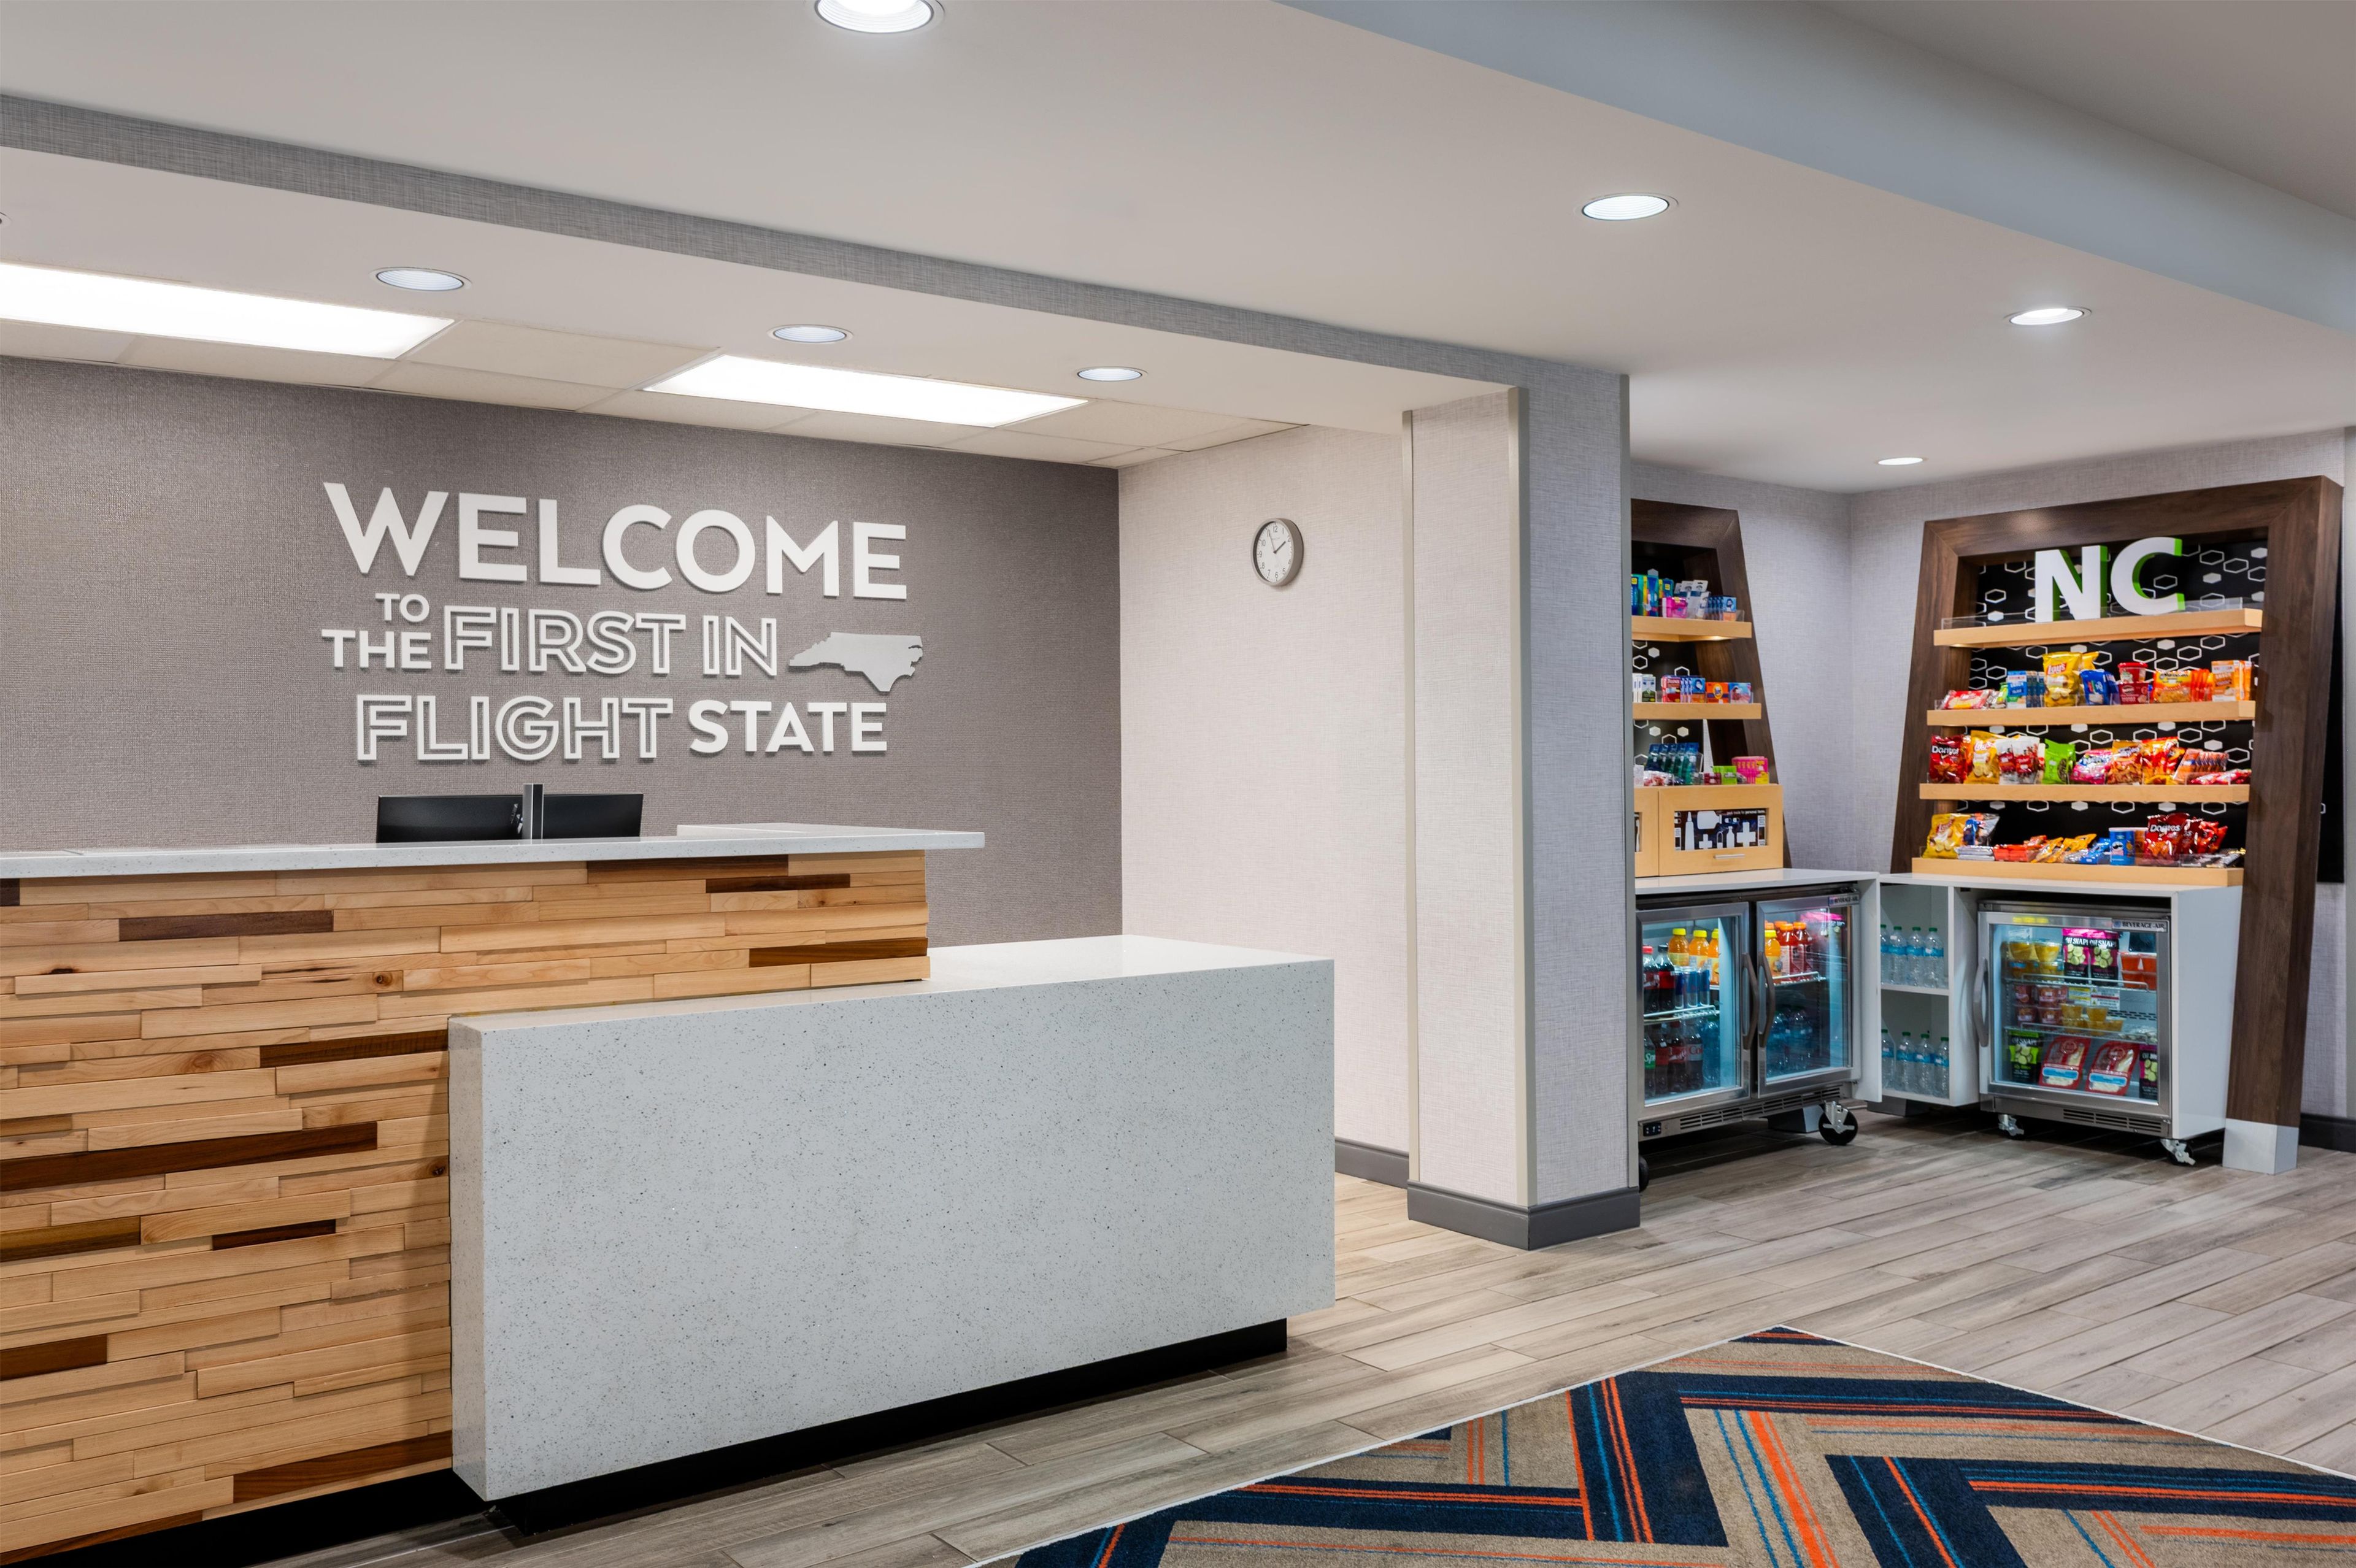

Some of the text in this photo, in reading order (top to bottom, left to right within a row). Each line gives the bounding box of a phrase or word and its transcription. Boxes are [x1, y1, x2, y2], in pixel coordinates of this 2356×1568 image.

[323, 482, 907, 599] WELCOME
[375, 593, 430, 623] TO
[2035, 537, 2186, 623] NC
[321, 605, 777, 677] THE FIRST IN
[357, 694, 887, 761] FLIGHT STATE
[2149, 824, 2181, 833] Doritos
[2122, 921, 2165, 929] BEVERAGE-AIR
